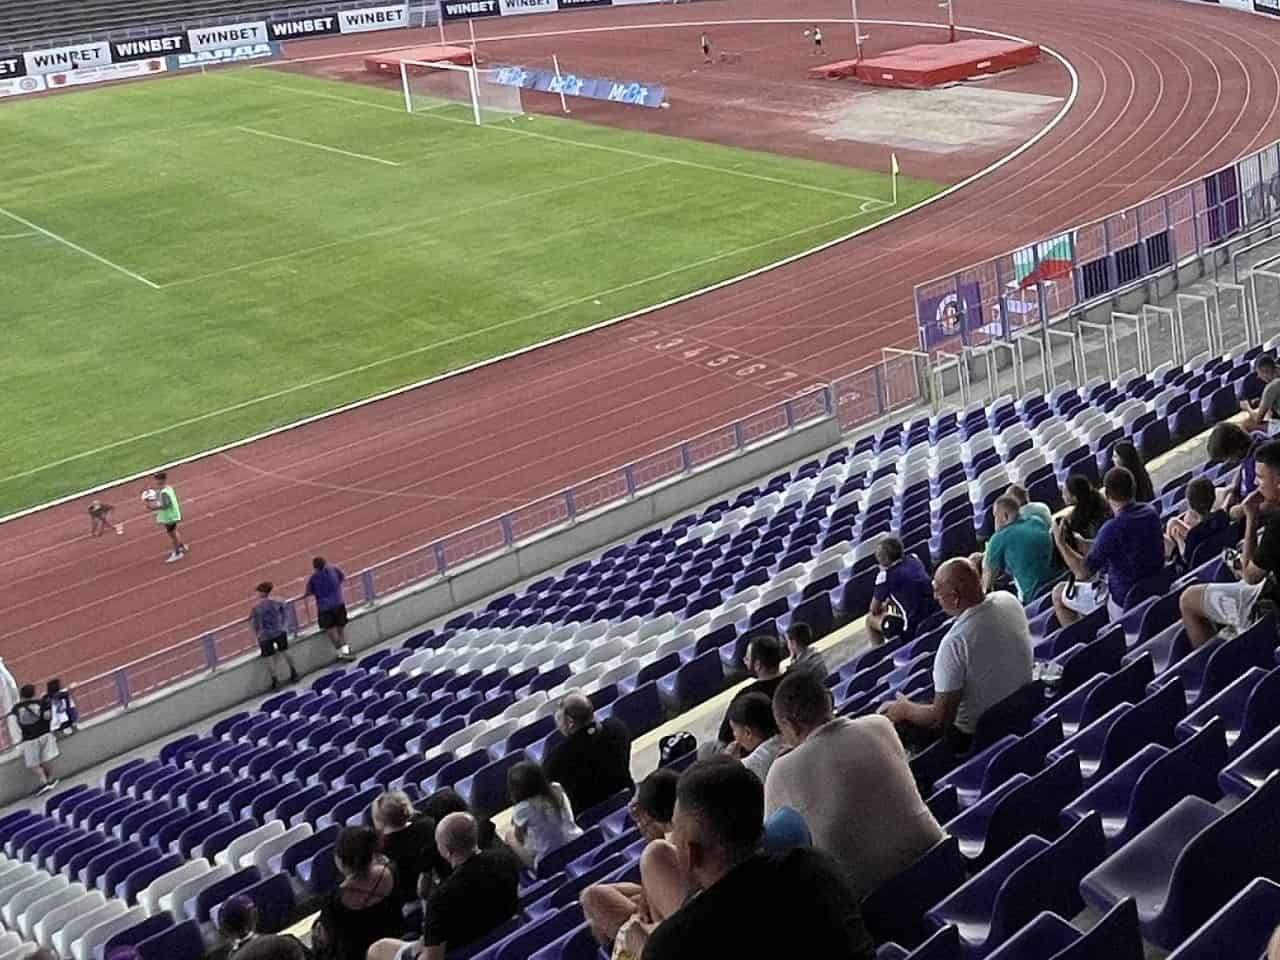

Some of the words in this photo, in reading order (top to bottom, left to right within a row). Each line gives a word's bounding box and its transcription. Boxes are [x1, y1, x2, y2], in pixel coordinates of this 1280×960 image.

[345, 8, 403, 25] WINBET
[446, 0, 496, 15] WINBET
[196, 26, 258, 45] WINBET
[272, 17, 334, 36] WINBET
[116, 36, 184, 57] WINBET
[34, 48, 102, 67] WINBET
